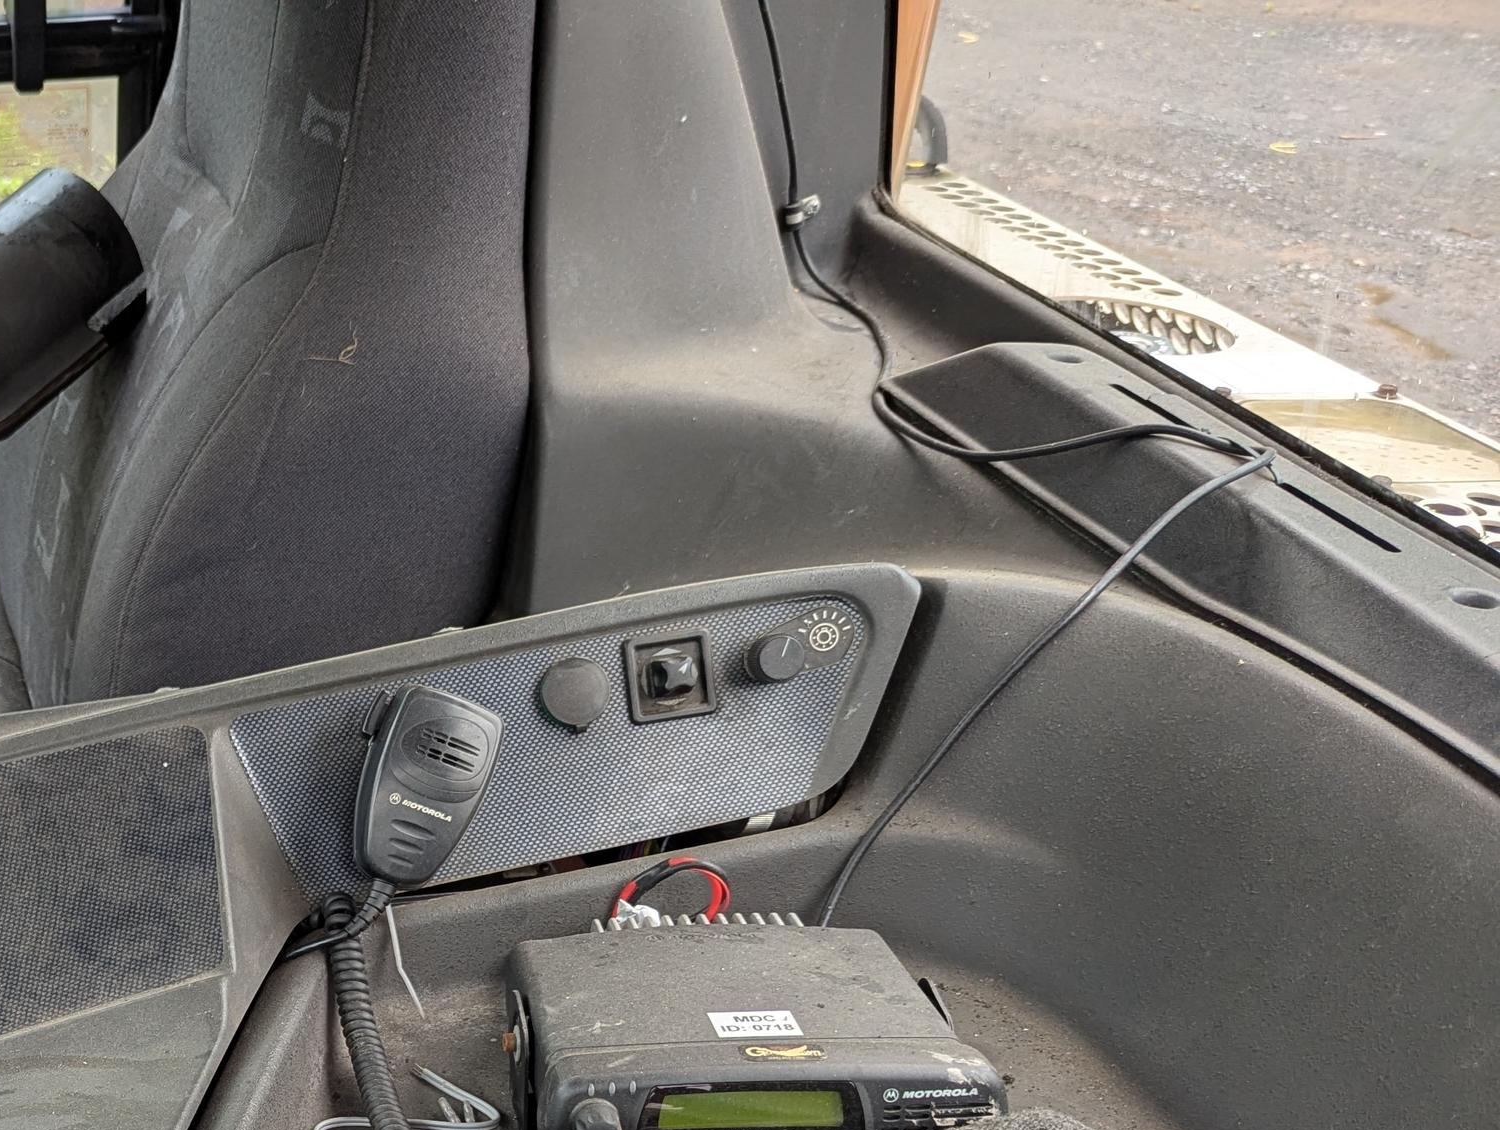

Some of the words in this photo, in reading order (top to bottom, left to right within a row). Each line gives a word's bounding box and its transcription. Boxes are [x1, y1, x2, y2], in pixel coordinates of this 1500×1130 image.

[401, 799, 453, 822] MOTOROLA
[732, 1015, 776, 1023] MDC
[720, 1024, 747, 1033] ID:
[902, 1088, 979, 1099] MOTOROLA
